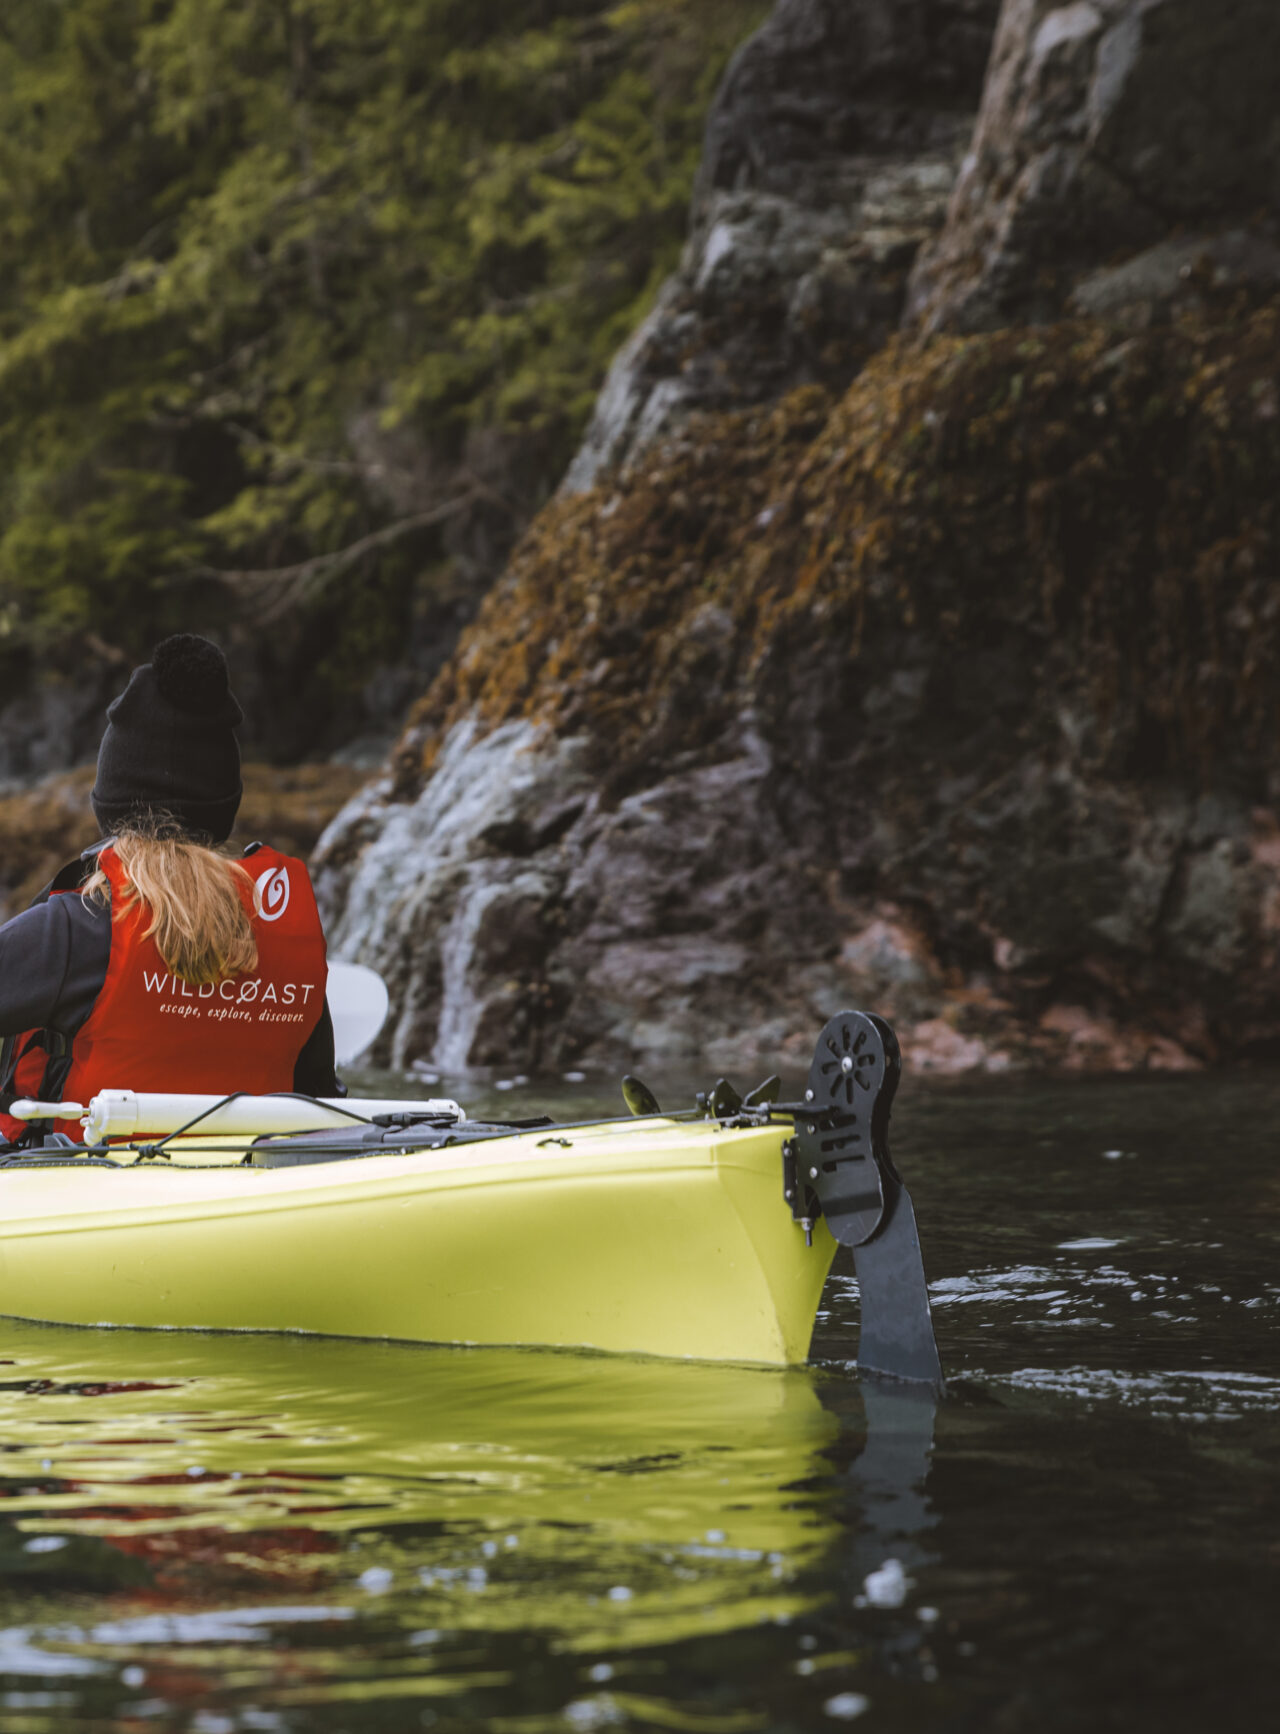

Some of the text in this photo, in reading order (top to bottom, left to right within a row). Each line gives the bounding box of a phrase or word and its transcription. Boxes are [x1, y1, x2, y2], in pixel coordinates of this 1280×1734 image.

[159, 1003, 305, 1023] escape, explore, discover.
